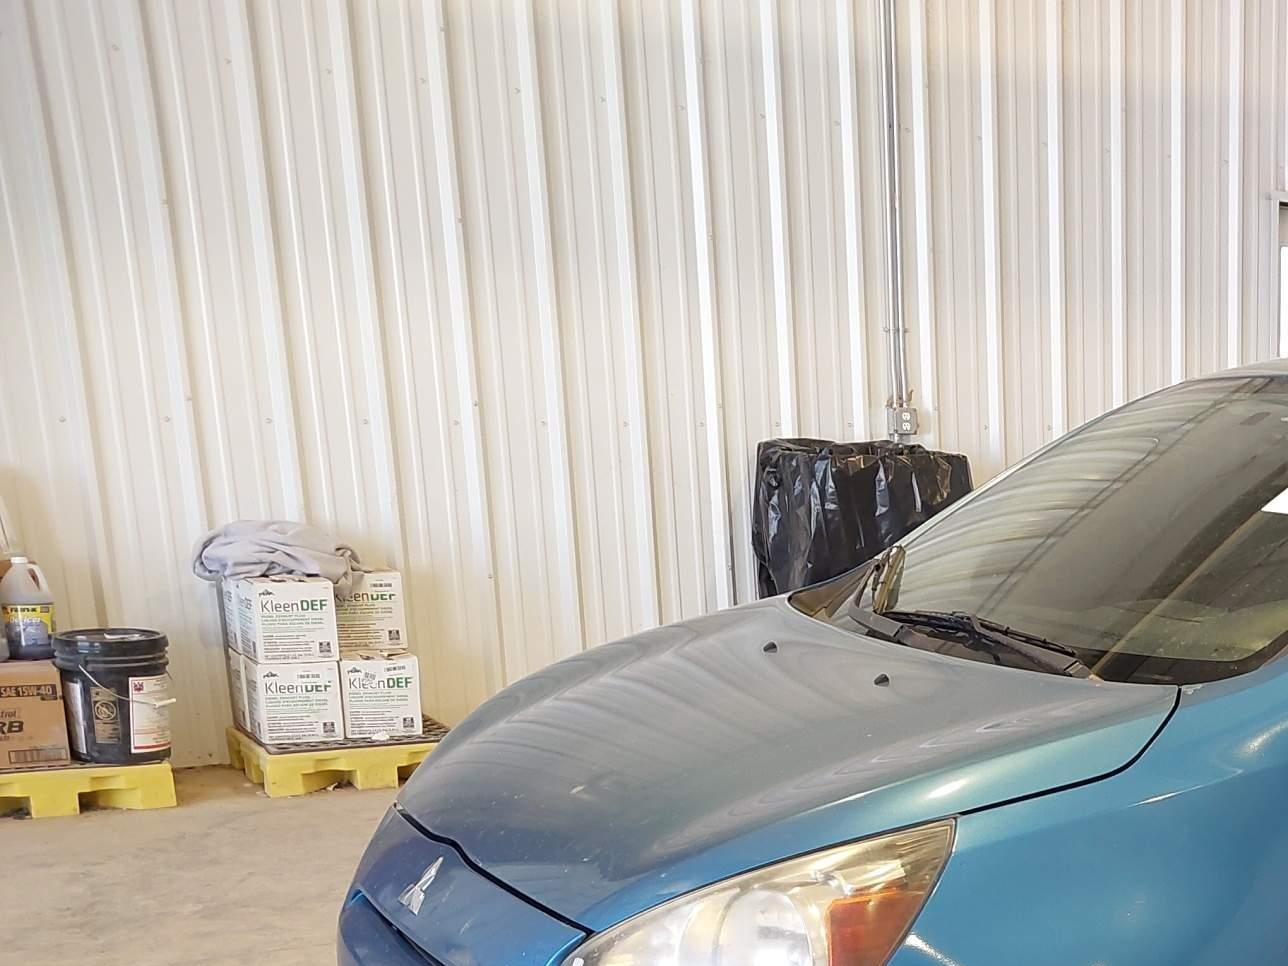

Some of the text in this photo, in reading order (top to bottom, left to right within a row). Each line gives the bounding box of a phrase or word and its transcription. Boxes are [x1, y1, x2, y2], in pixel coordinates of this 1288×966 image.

[261, 599, 329, 613] KleenDEF
[0, 684, 53, 697] SAE 15W-40
